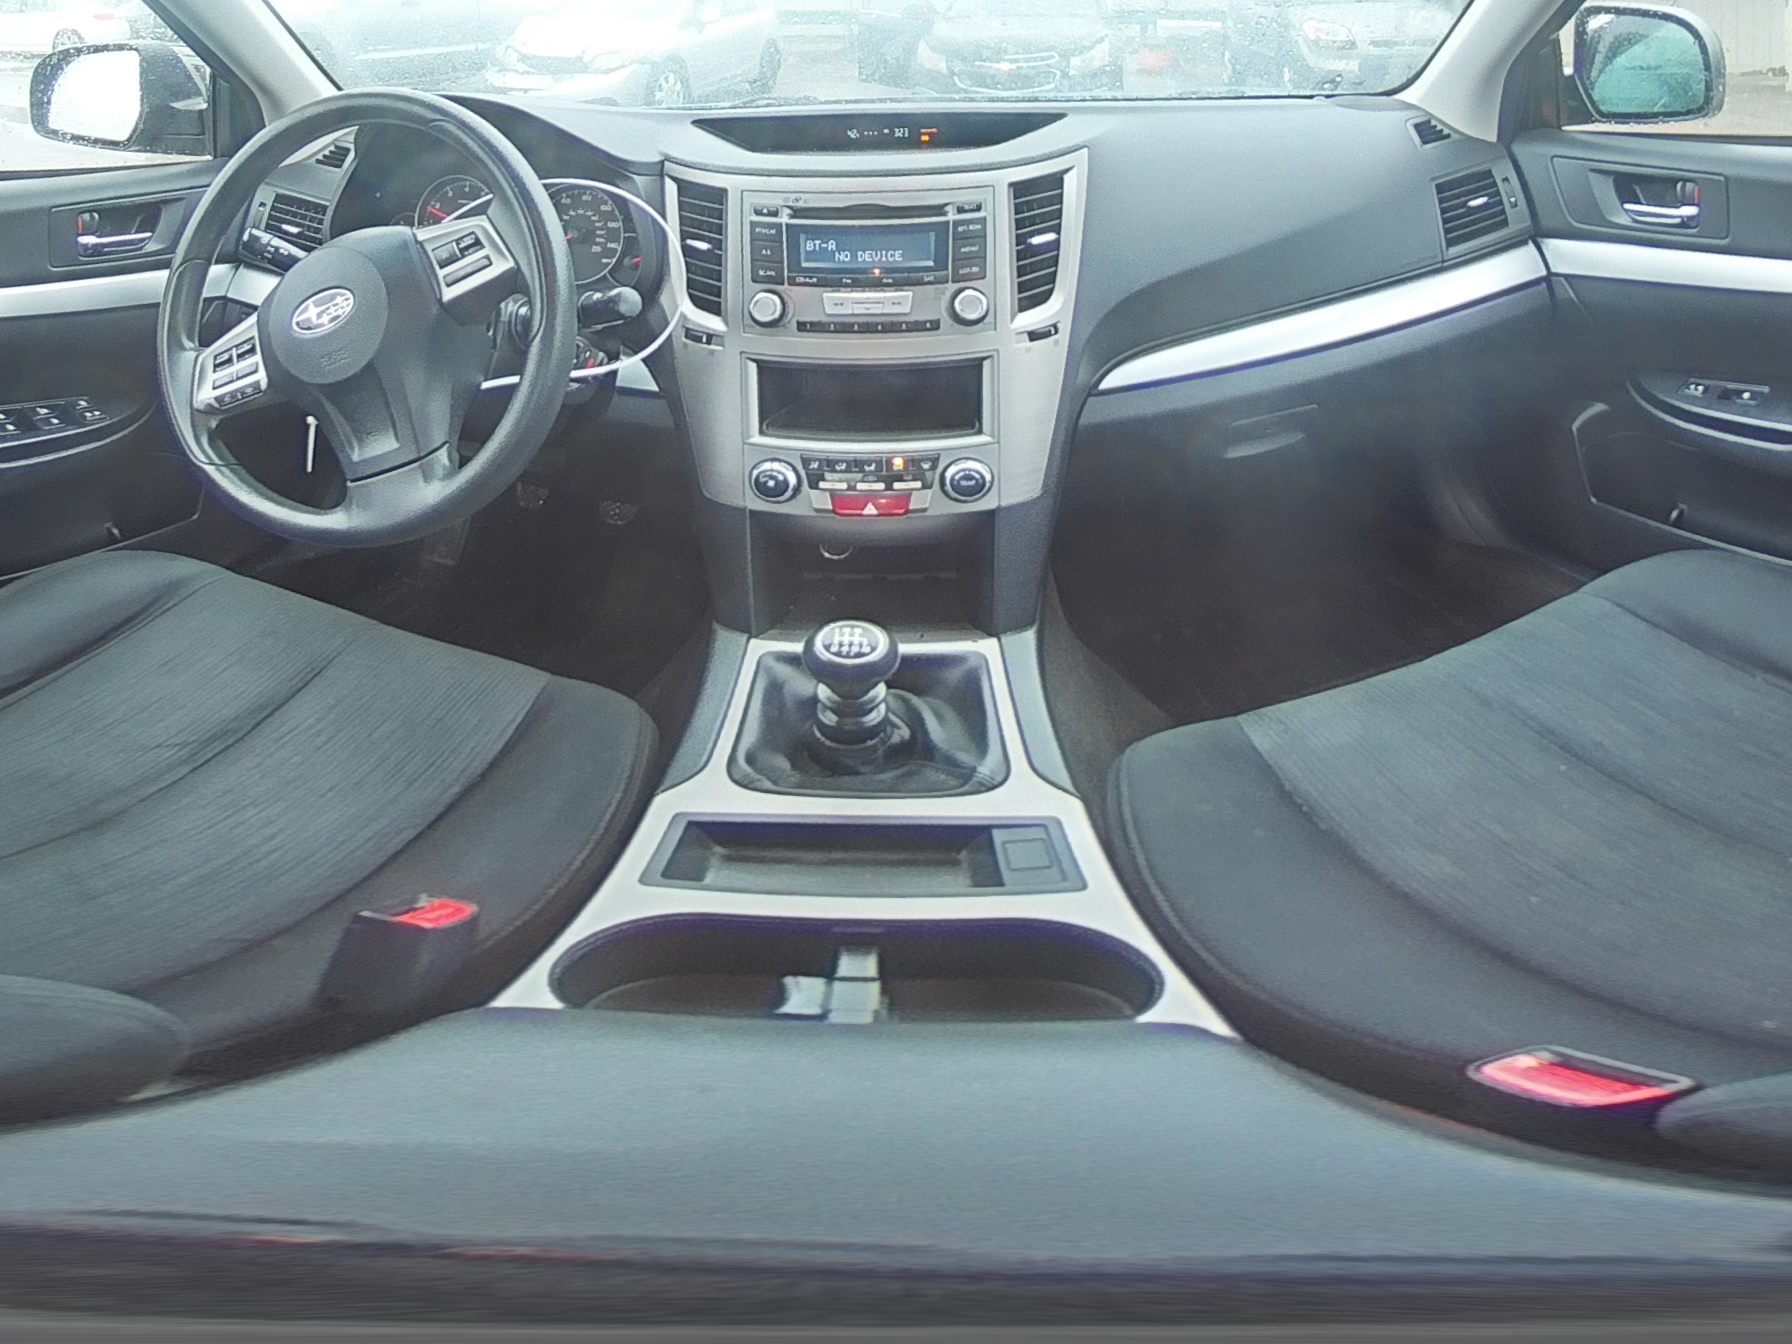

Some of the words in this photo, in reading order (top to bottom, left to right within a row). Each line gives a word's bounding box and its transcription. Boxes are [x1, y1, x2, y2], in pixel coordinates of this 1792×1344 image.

[806, 240, 837, 252] BT-A
[834, 251, 851, 262] NO
[857, 250, 903, 262] DEVICE
